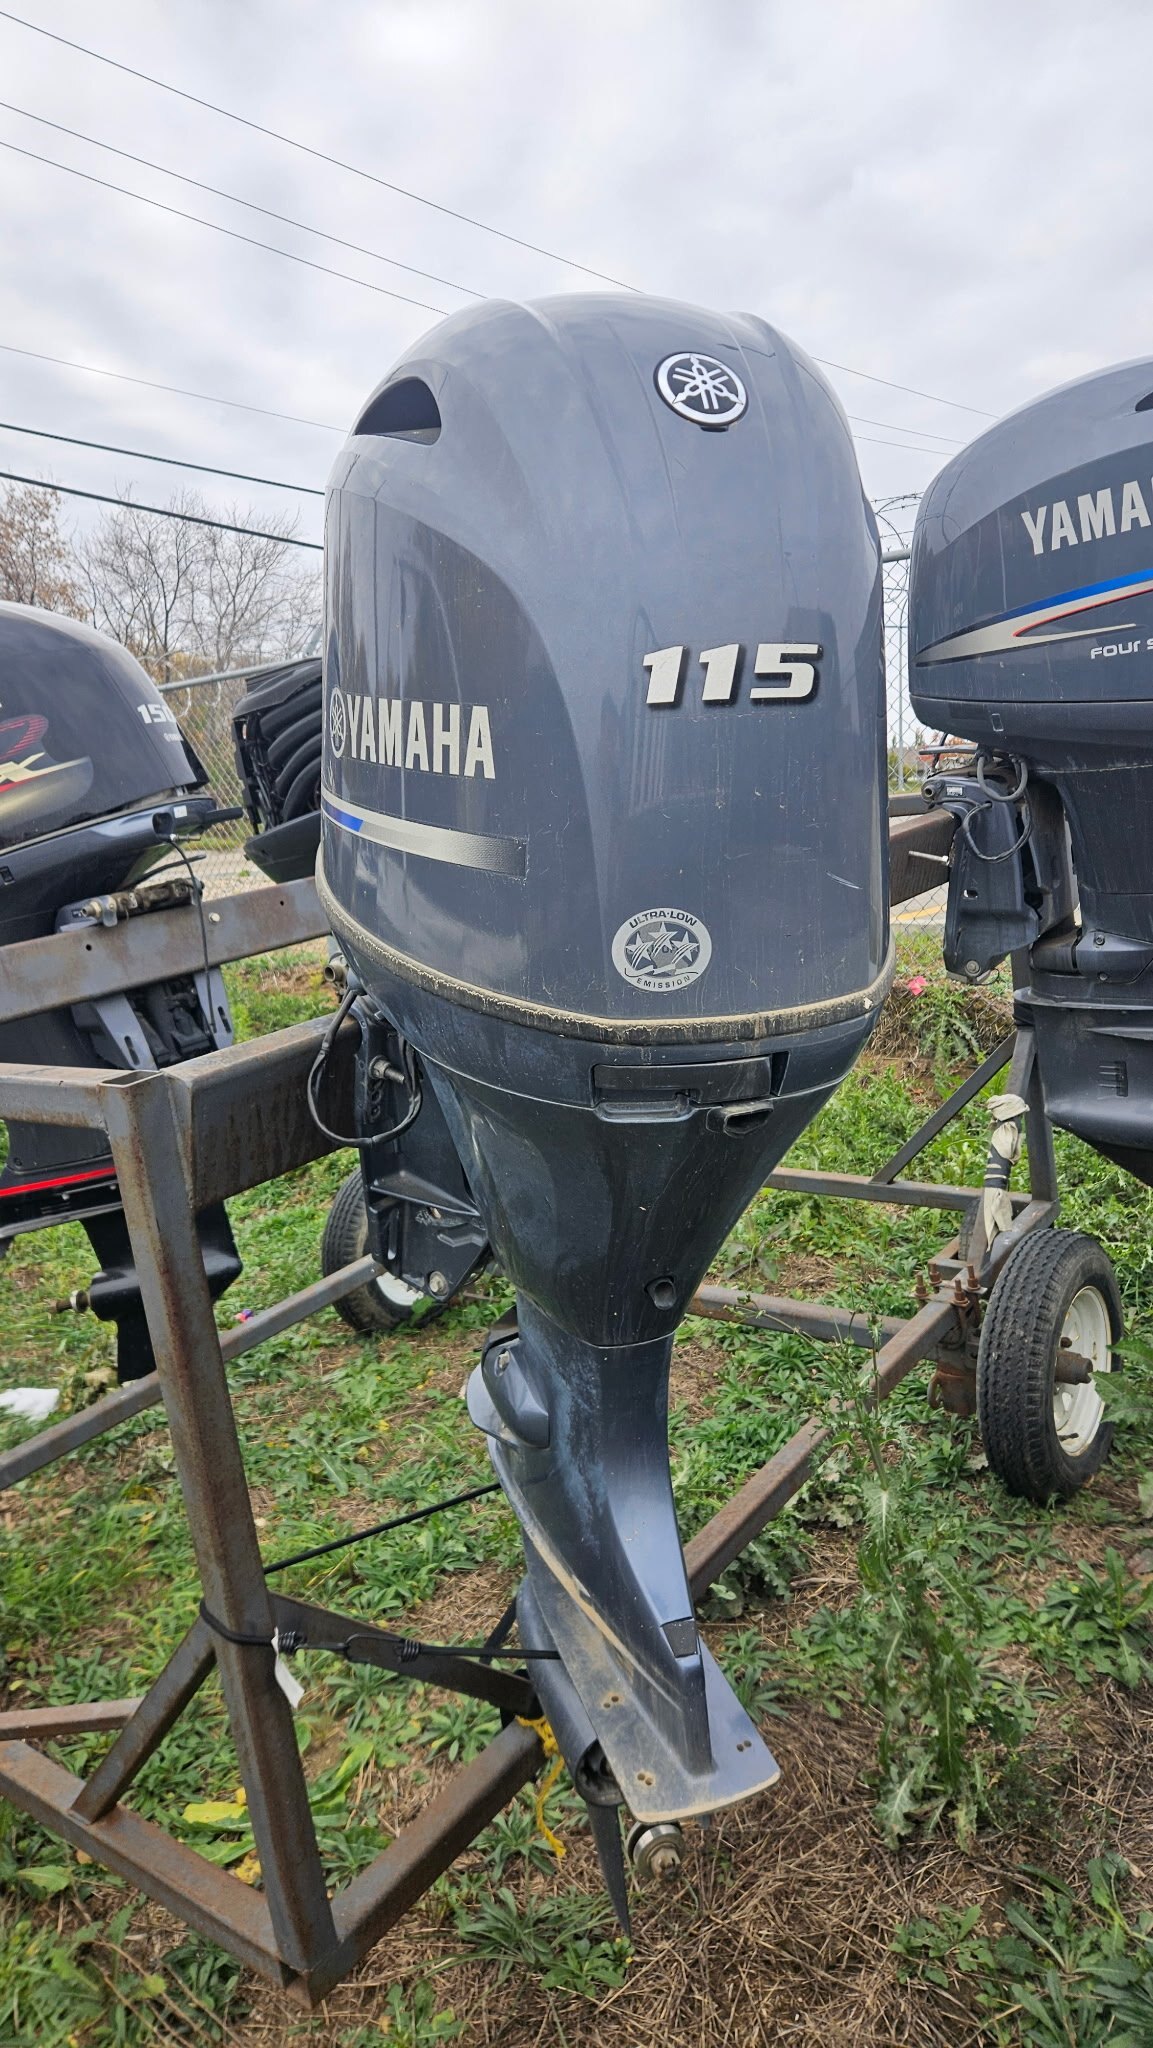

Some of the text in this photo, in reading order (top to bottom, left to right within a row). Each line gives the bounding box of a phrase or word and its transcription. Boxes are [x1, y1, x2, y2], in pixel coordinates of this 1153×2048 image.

[1020, 477, 1153, 556] YAMA
[643, 643, 819, 706] 115
[346, 693, 496, 780] YAMAHA
[636, 976, 691, 989] EMISSION
